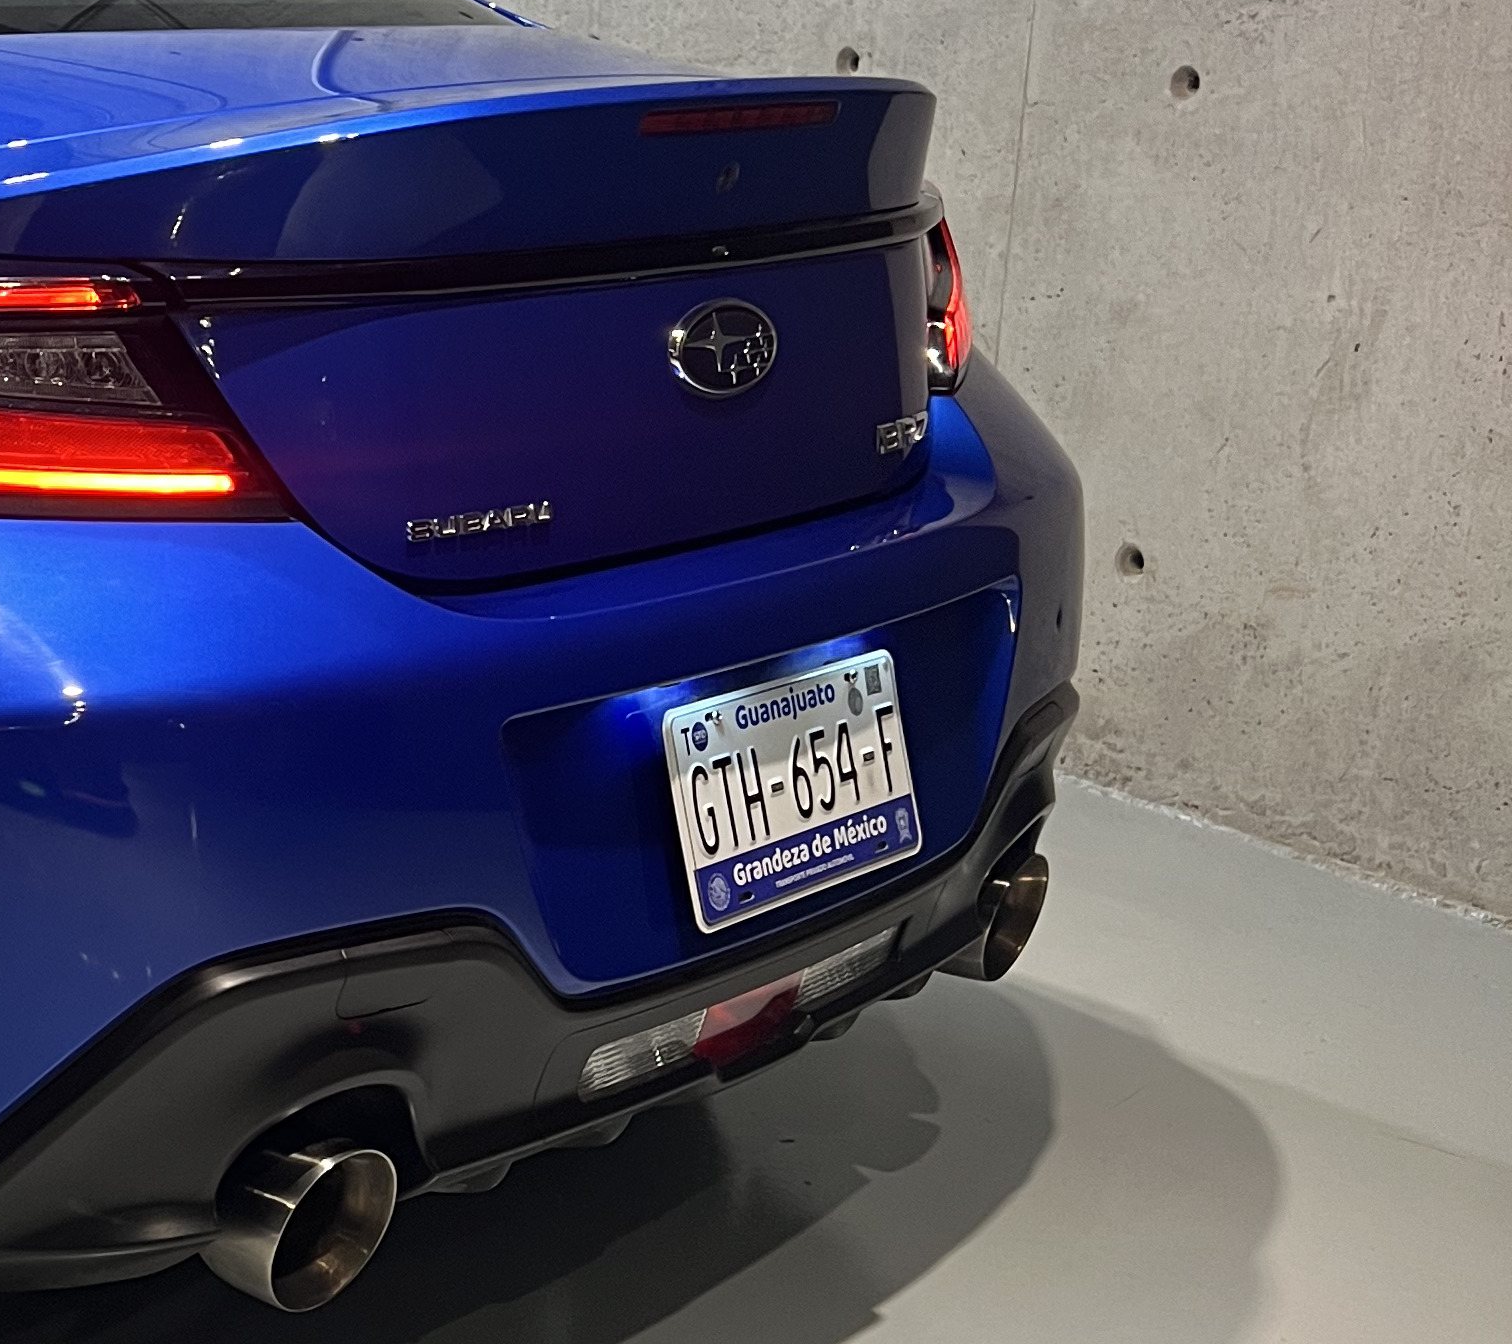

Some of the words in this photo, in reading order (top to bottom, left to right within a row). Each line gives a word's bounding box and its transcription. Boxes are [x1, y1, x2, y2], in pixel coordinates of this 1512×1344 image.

[405, 500, 554, 542] SUBARU
[735, 683, 835, 730] Guanajuato
[691, 705, 893, 855] GTH-654-F
[733, 843, 810, 886] Grandeza
[811, 833, 833, 858] de
[833, 814, 888, 850] México
